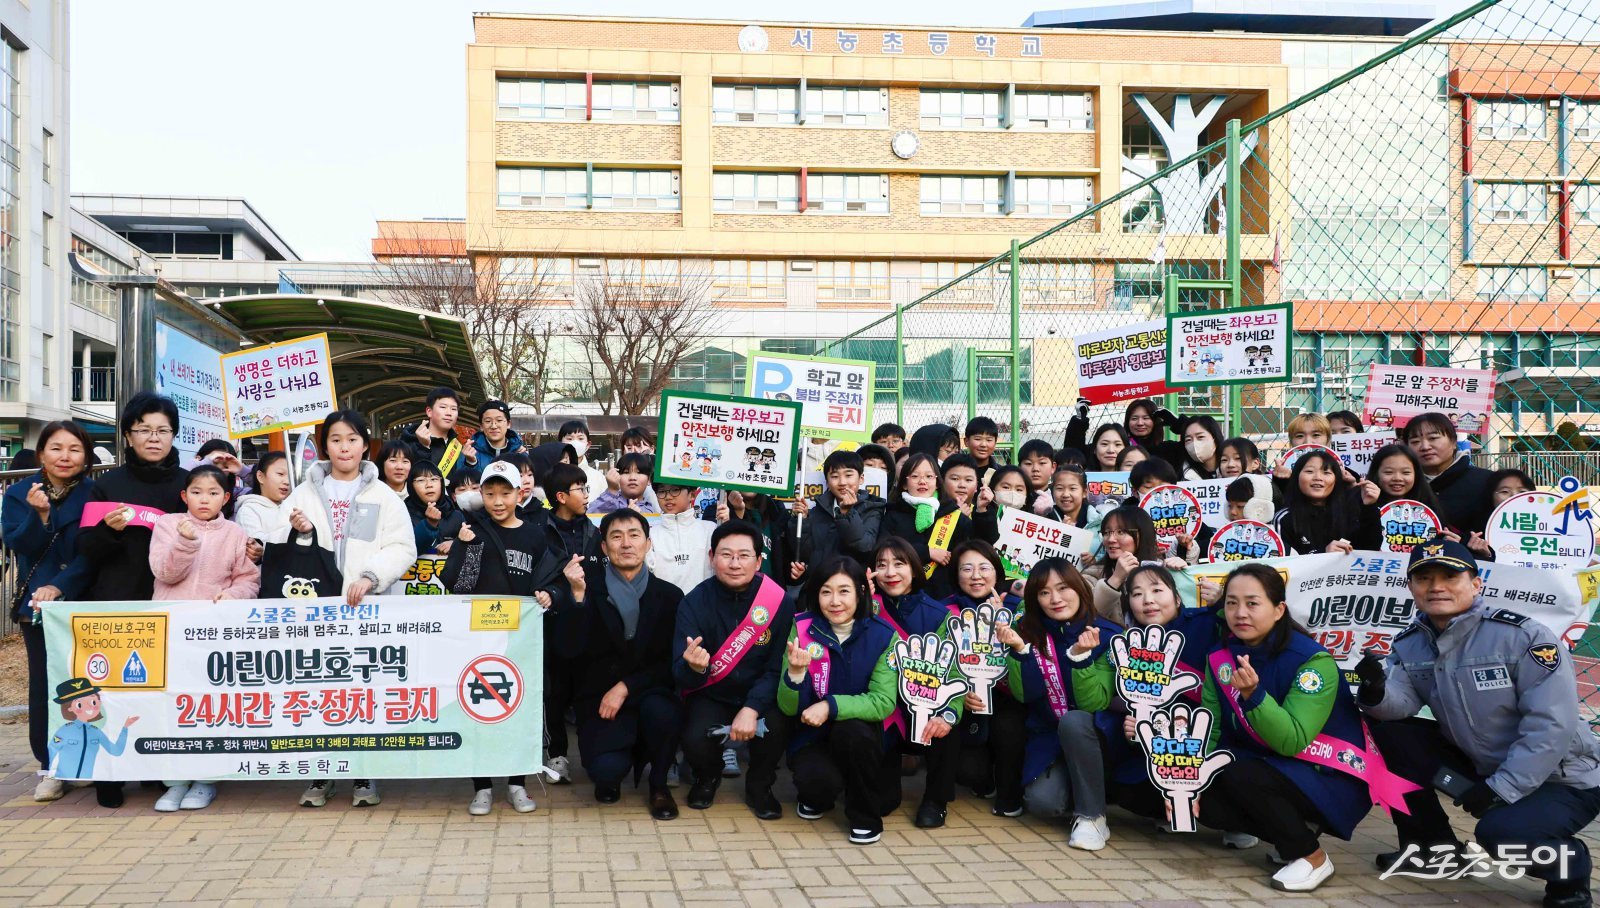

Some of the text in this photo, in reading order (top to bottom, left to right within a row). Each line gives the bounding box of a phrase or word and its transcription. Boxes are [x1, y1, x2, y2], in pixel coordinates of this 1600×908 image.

[791, 28, 1042, 57] 서농초등학교
[1181, 313, 1278, 334] 건널때는 좌우보고
[1186, 329, 1275, 348] 안전보행 하세요!
[1079, 338, 1124, 358] 바로보자
[233, 350, 319, 383] 생명은 더하고
[1080, 358, 1126, 378] 바로걷자
[1239, 366, 1282, 375] 서농초등학교
[236, 371, 322, 401] 사랑은 나눠요
[754, 361, 793, 400] P
[807, 368, 864, 390] 학교 앞
[1382, 374, 1479, 393] 교문 앞 주정차를
[795, 387, 863, 405] 불법 주정차
[1112, 385, 1149, 397] 서농초등학교
[292, 400, 329, 414] 서농초등학교
[1395, 394, 1459, 410] 피해주세요
[677, 403, 785, 426] 건널때는 좌우보고
[827, 405, 861, 424] 금지
[681, 422, 780, 443] 안전보행 하세요!
[800, 428, 831, 437] 초등학교
[737, 472, 783, 484] 서농초등학교
[1087, 481, 1128, 496] 멈추고!
[1150, 504, 1187, 520] 휴대폰
[1386, 519, 1427, 536] 휴대폰
[1499, 512, 1548, 531] 사람이
[1012, 517, 1072, 549] 교통신호를
[1225, 539, 1269, 558] 휴대폰
[1520, 536, 1586, 557] 우선입니다
[1350, 557, 1402, 574] 스쿨존
[1299, 577, 1325, 592] 안전한
[1326, 574, 1381, 587] 등하굣길을
[1384, 575, 1409, 589] 위해
[1504, 589, 1557, 606] 배려해요
[247, 604, 379, 624] 스쿨존 교통안전!
[1306, 594, 1415, 628] 어린이보
[81, 622, 156, 635] 어린이보호구역
[184, 621, 442, 641] 안전한 등하굣길을 위해 멈추고, 살피고 배려해요
[82, 637, 155, 649] SCHOOL ZONE
[971, 642, 993, 654] 보다
[985, 654, 1007, 667] 가다
[1129, 647, 1165, 662] 천천히
[90, 660, 106, 674] 30
[207, 645, 408, 686] 어린이보호구역
[902, 656, 947, 678] 자전거는
[1128, 657, 1164, 672] 걸어요
[1119, 667, 1172, 686] 절대 뛰지
[1476, 668, 1508, 681] 경찰
[1479, 679, 1509, 688] POLICE
[906, 682, 937, 700] 함께!
[1124, 678, 1163, 696] 않아요
[176, 691, 275, 728] 24시간
[384, 687, 439, 724] 금지
[144, 735, 457, 752] 어린이보호구역 주 정차 위반시 일반도로의 약 3배의 과태료 12만원 부과 됩니다.
[1151, 736, 1202, 754] 휴대폰
[237, 759, 350, 775] 서농초등학교
[1175, 755, 1204, 768] 때는
[1157, 765, 1199, 780] 안돼요!
